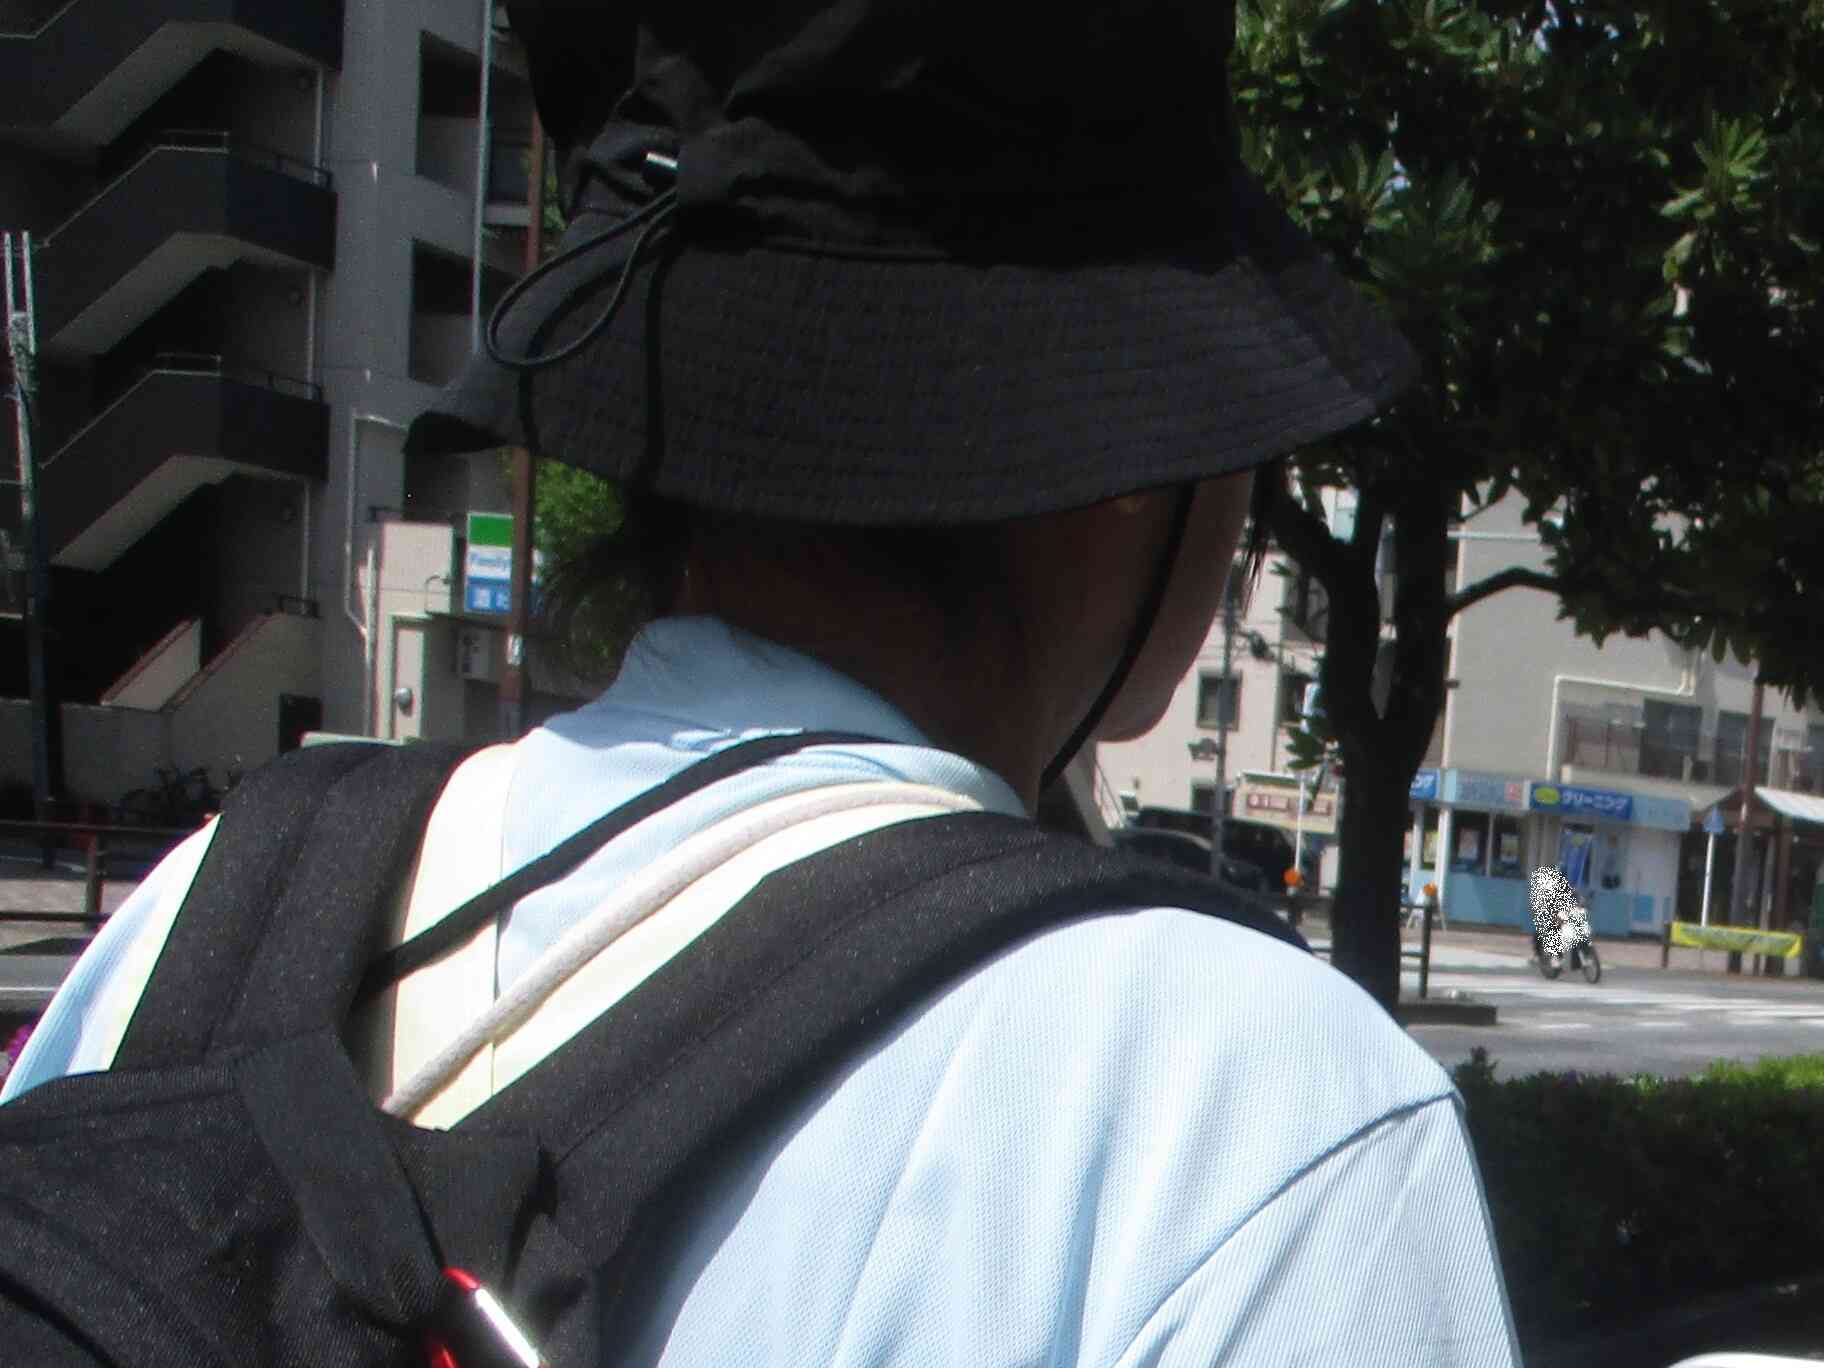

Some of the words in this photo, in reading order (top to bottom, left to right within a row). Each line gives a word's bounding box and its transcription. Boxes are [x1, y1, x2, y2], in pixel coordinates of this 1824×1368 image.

[1561, 791, 1627, 811] クリーニング
